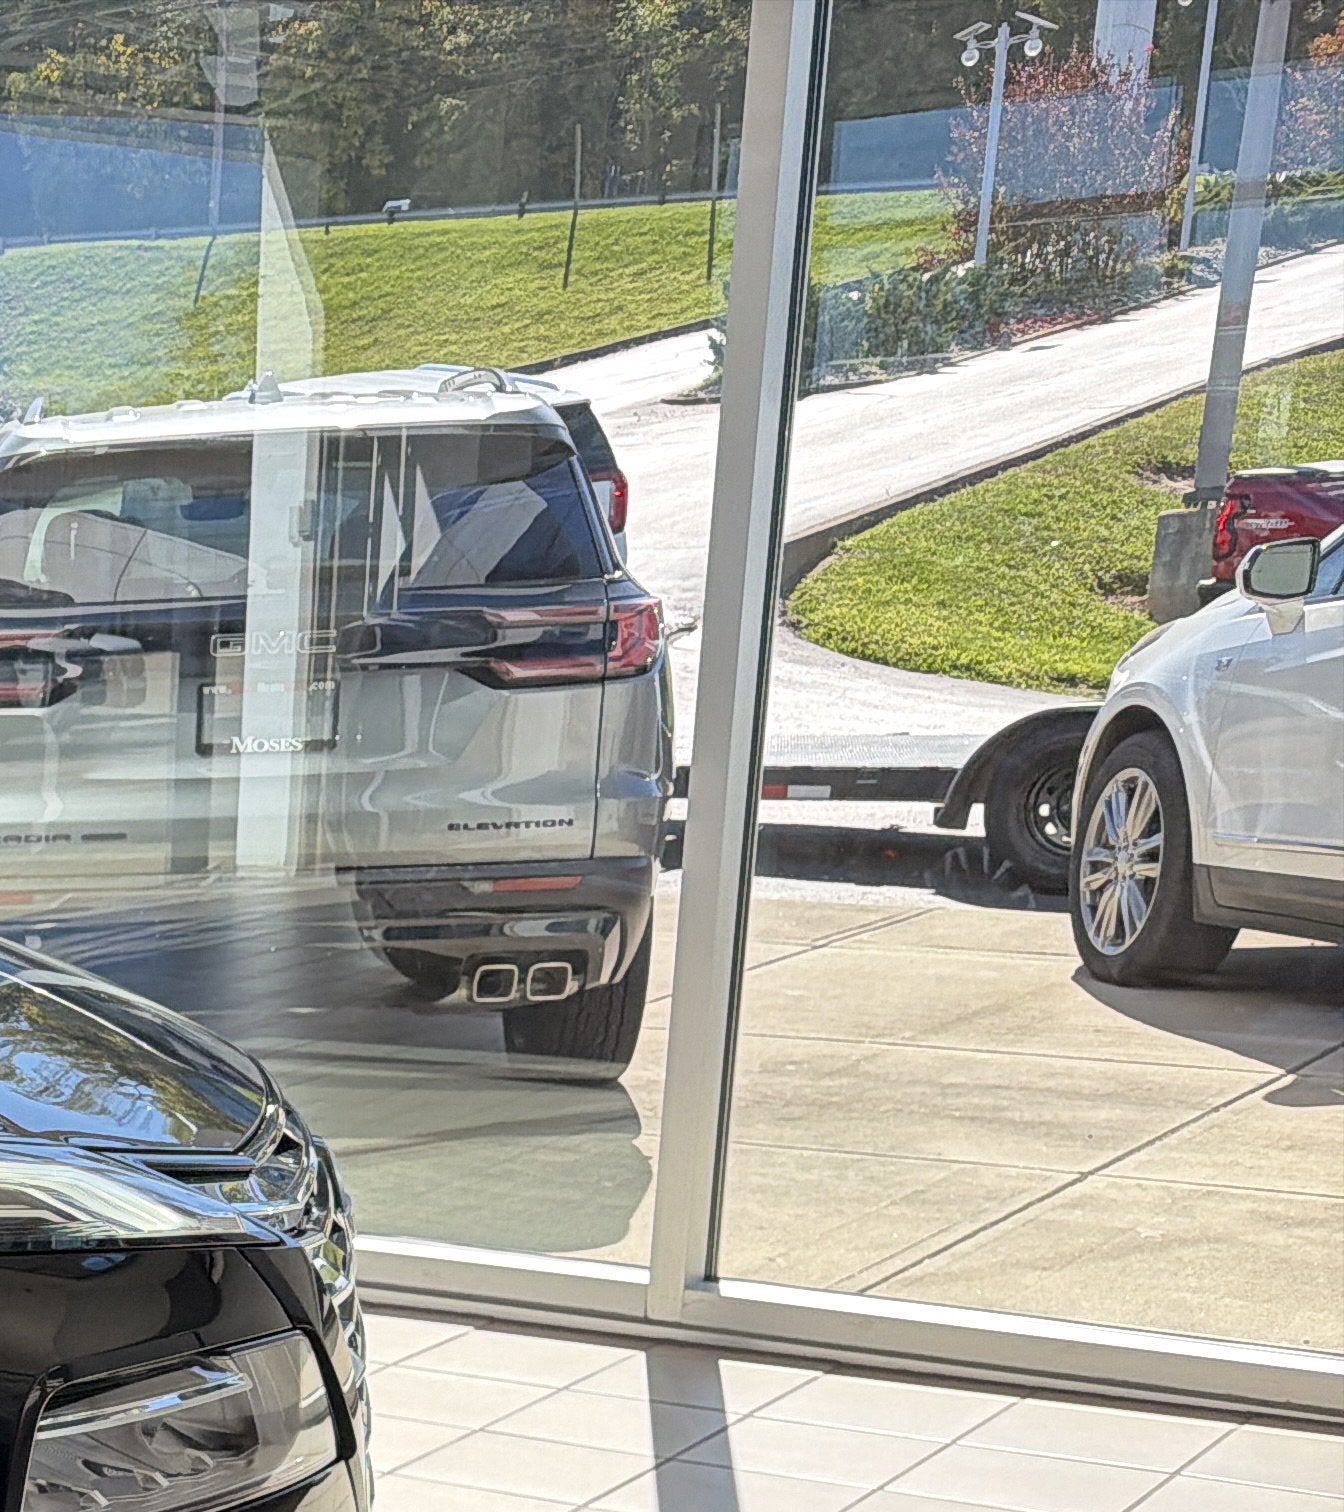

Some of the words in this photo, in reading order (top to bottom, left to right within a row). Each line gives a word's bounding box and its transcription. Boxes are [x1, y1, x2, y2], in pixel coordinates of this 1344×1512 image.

[210, 629, 338, 657] GMC
[230, 736, 305, 753] MOSES
[447, 818, 574, 831] ELEVATION
